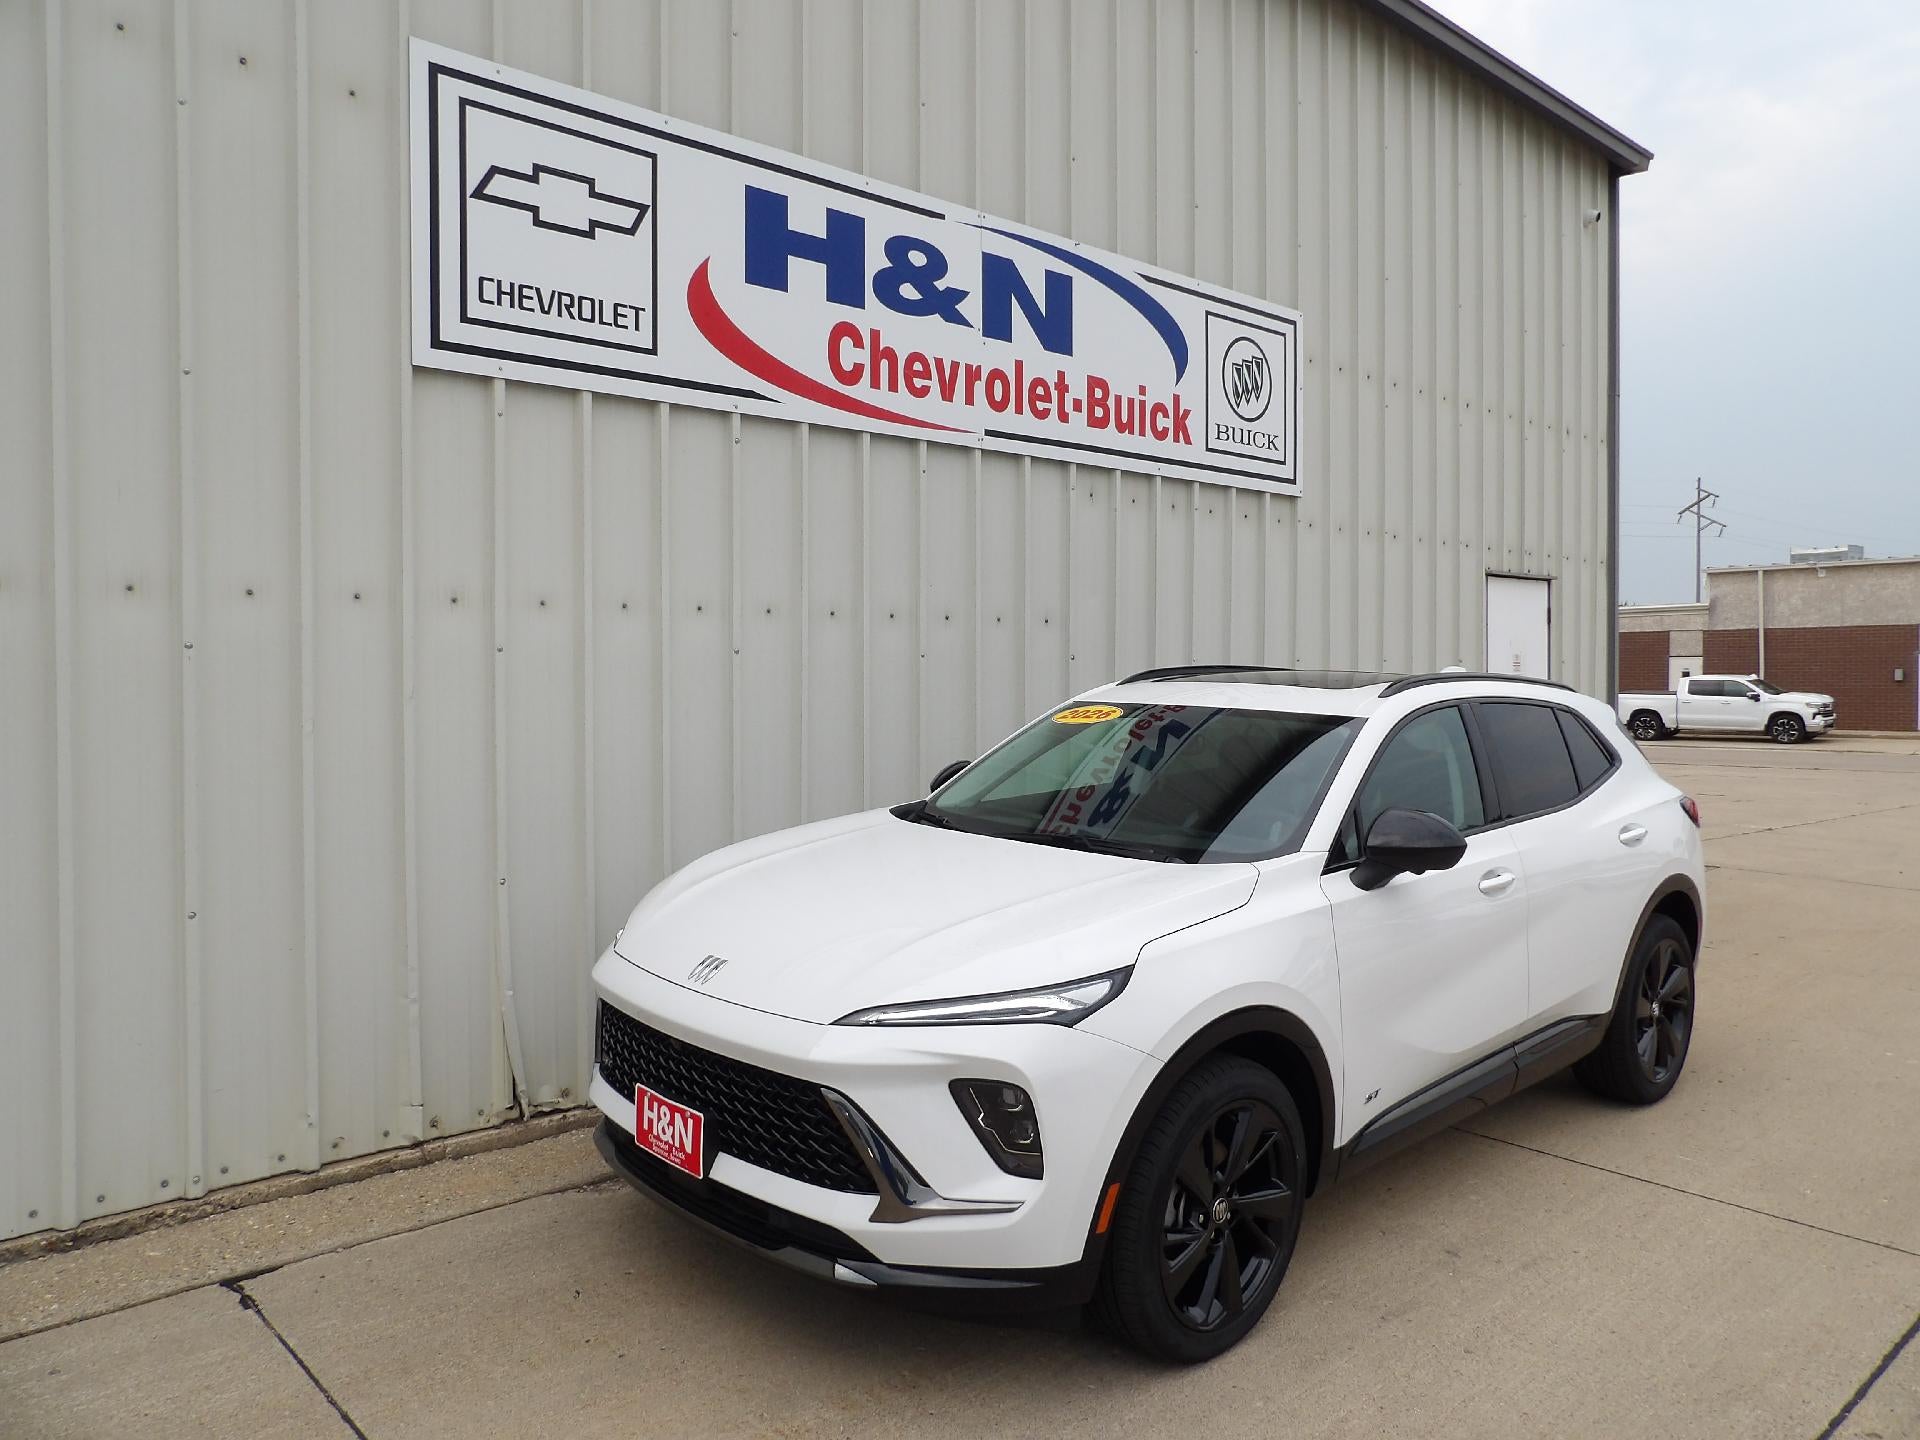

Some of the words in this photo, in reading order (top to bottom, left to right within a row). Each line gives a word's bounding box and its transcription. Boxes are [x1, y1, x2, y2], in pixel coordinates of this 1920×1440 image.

[745, 185, 1073, 356] H&N
[478, 276, 646, 333] CHEVROLET
[827, 320, 1193, 446] Chevrolet-Buick
[1214, 422, 1280, 454] BUICK
[1058, 708, 1118, 720] 2026
[643, 1095, 693, 1154] H&N
